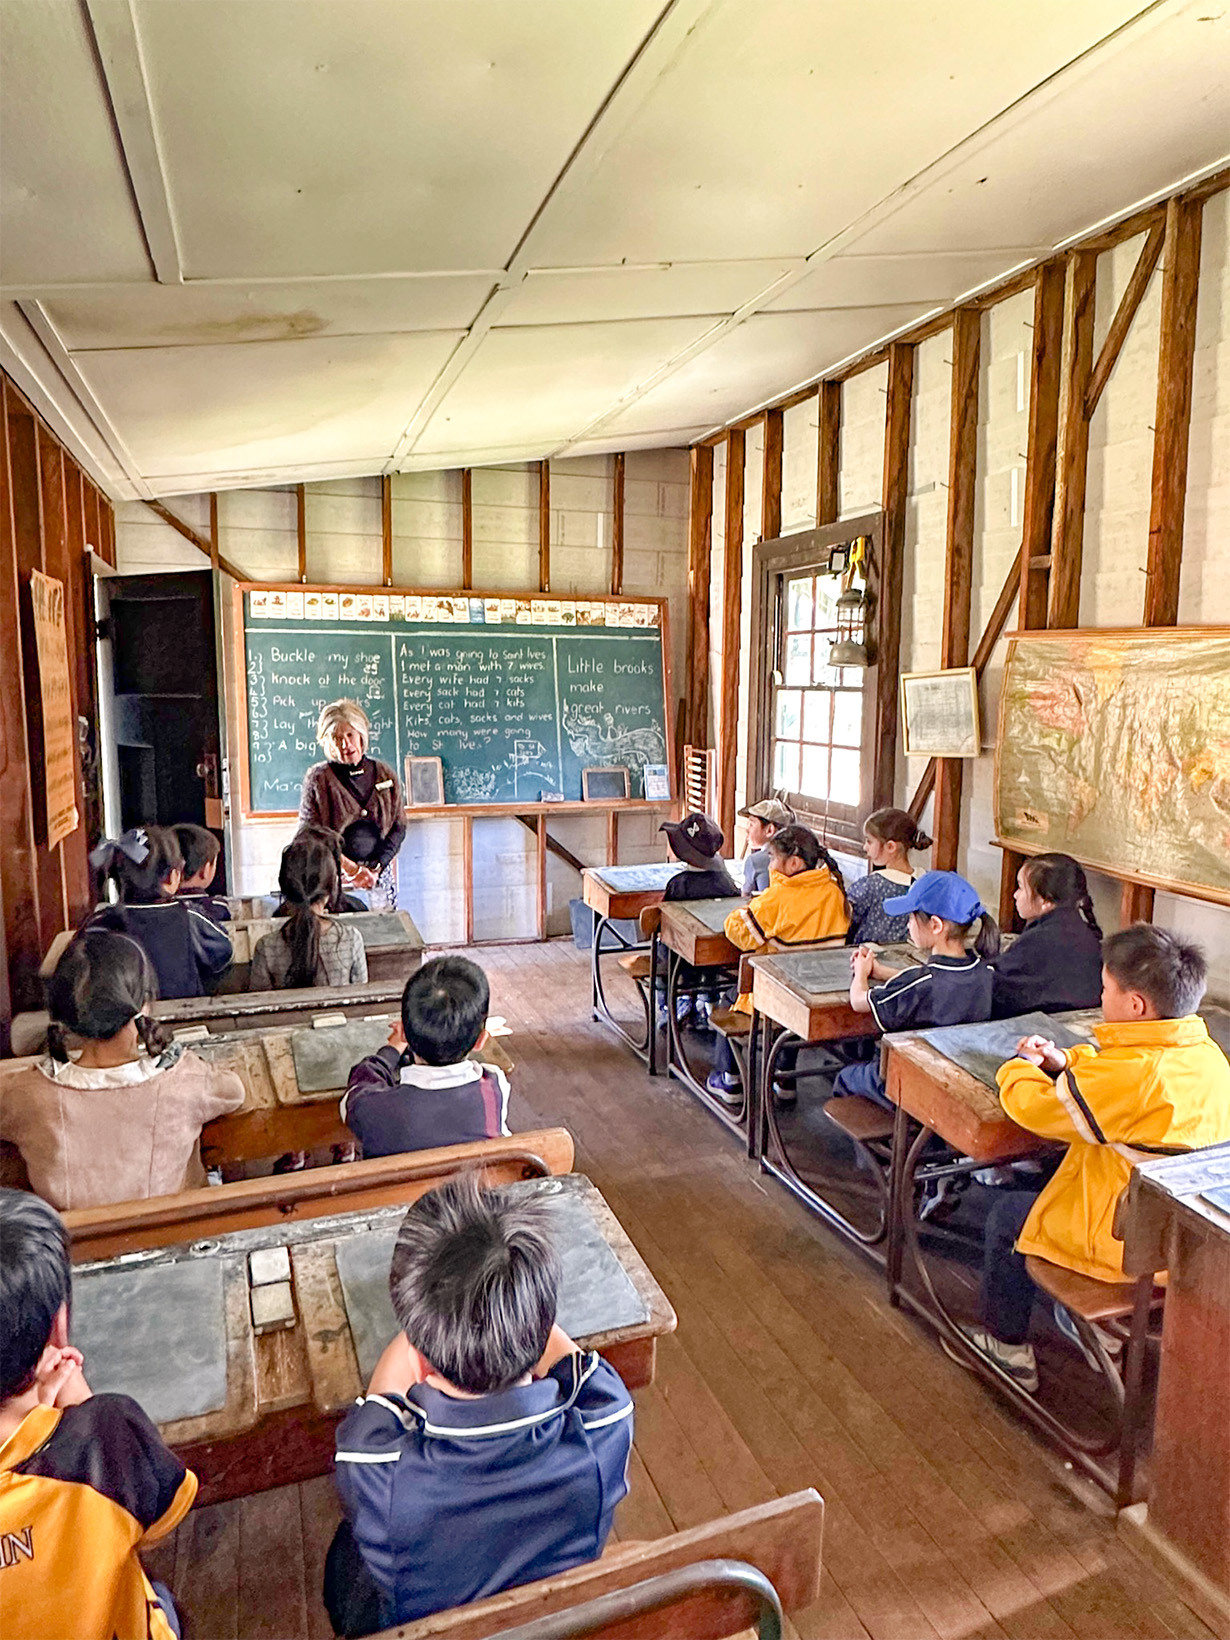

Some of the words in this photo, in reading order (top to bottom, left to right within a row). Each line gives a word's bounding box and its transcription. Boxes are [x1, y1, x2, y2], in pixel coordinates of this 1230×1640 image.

[271, 646, 316, 663] Buckle
[328, 653, 349, 669] my
[354, 652, 381, 664] shoe
[400, 643, 414, 657] As
[430, 648, 451, 658] was
[489, 648, 499, 660] to
[527, 646, 546, 660] Ives
[247, 661, 256, 674] 2
[409, 660, 431, 672] met
[435, 663, 441, 671] a
[447, 663, 471, 672] man
[479, 660, 502, 672] with
[507, 661, 514, 670] 7
[568, 654, 604, 674] Little
[614, 658, 654, 675] brooks
[249, 674, 258, 685] 3
[318, 674, 330, 686] at
[338, 673, 357, 686] the
[360, 674, 385, 686] door
[402, 673, 433, 690] Every
[440, 673, 464, 685] wife
[469, 675, 489, 685] had
[509, 673, 535, 684] sacks
[570, 679, 604, 693] make
[403, 688, 431, 703] Every
[437, 687, 459, 697] sack
[466, 686, 485, 698] had
[506, 685, 525, 698] cats
[251, 697, 259, 707] 5
[273, 695, 296, 707] Pick
[311, 699, 326, 713] up
[403, 700, 433, 718] Every
[438, 700, 456, 710] cat
[464, 698, 485, 708] had
[494, 700, 500, 708] 7
[507, 697, 525, 708] kits
[252, 706, 259, 718] 6
[470, 712, 498, 723] sacks
[504, 713, 524, 722] and
[528, 713, 553, 722] wives
[571, 701, 604, 721] great
[615, 704, 651, 715] rivers
[251, 720, 259, 728] 7
[274, 718, 295, 735] Lay
[252, 730, 260, 740] 8
[407, 729, 428, 739] How
[437, 729, 469, 741] many
[473, 728, 498, 736] were
[252, 741, 260, 750] 9
[278, 739, 287, 751] A
[295, 738, 317, 757] big
[409, 740, 420, 751] to
[432, 739, 443, 751] St
[253, 753, 266, 763] 10
